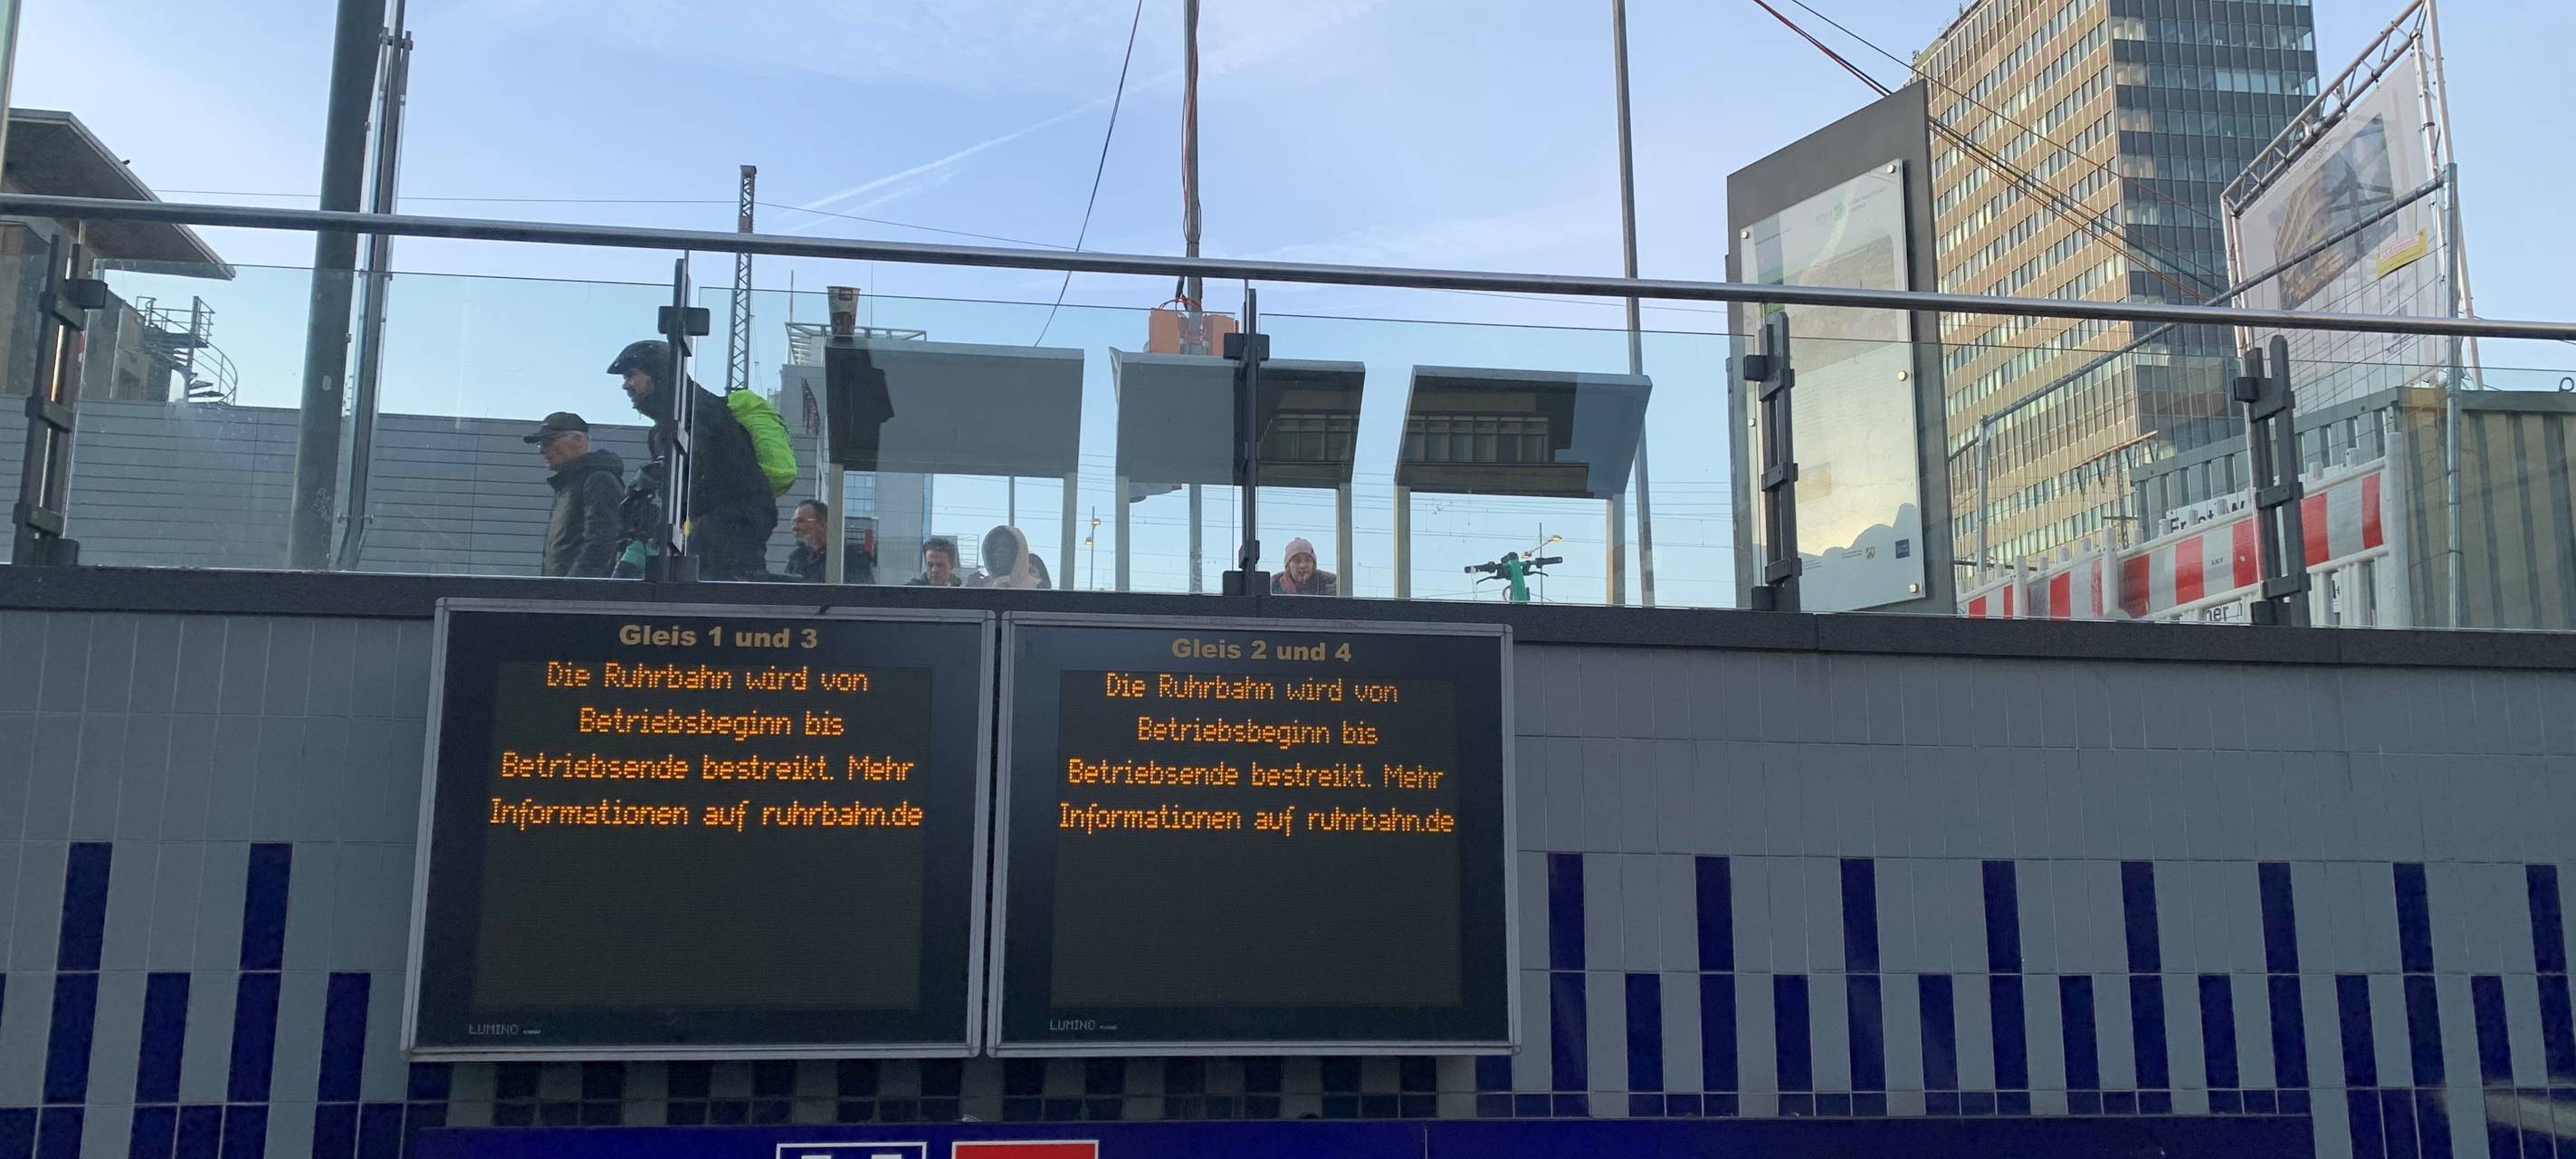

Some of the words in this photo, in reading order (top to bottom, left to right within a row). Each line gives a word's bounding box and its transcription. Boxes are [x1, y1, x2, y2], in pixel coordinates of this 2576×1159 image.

[619, 624, 697, 647] Gleis
[708, 626, 723, 647] 1
[735, 627, 789, 647] und
[800, 627, 817, 648] 3
[1171, 637, 1242, 660] Gleis
[1250, 639, 1268, 660] 2
[1276, 641, 1325, 662] und
[1333, 642, 1352, 662] 4
[547, 661, 591, 687] Die
[604, 663, 732, 690] Ruhrbahn
[746, 665, 809, 692] wird
[820, 673, 869, 693] von
[1106, 672, 1147, 698] Die
[1158, 674, 1274, 701] Ruhrbahn
[1286, 678, 1343, 703] wird
[1355, 685, 1398, 703] von
[579, 706, 792, 742] Betriebsbeginn
[805, 711, 844, 736] bis
[1137, 716, 1331, 750] Betriebsbeginn
[1341, 721, 1379, 745] bis
[501, 751, 690, 780] Betriebsende
[701, 753, 835, 781] bestreikt.
[847, 755, 914, 781] Mehr
[1067, 758, 1239, 786] Betriebsende
[1251, 761, 1372, 789] bestreikt.
[1383, 764, 1444, 790] Mehr
[491, 797, 689, 830] Informationen
[701, 800, 749, 832] auf
[761, 800, 924, 828] ruhrbahn.de
[1059, 801, 1241, 834] Informationen
[1254, 806, 1295, 837] auf
[1307, 806, 1455, 834] ruhrbahn.de
[469, 1023, 520, 1036] LUMINO
[1049, 1020, 1096, 1030] LUMINO
